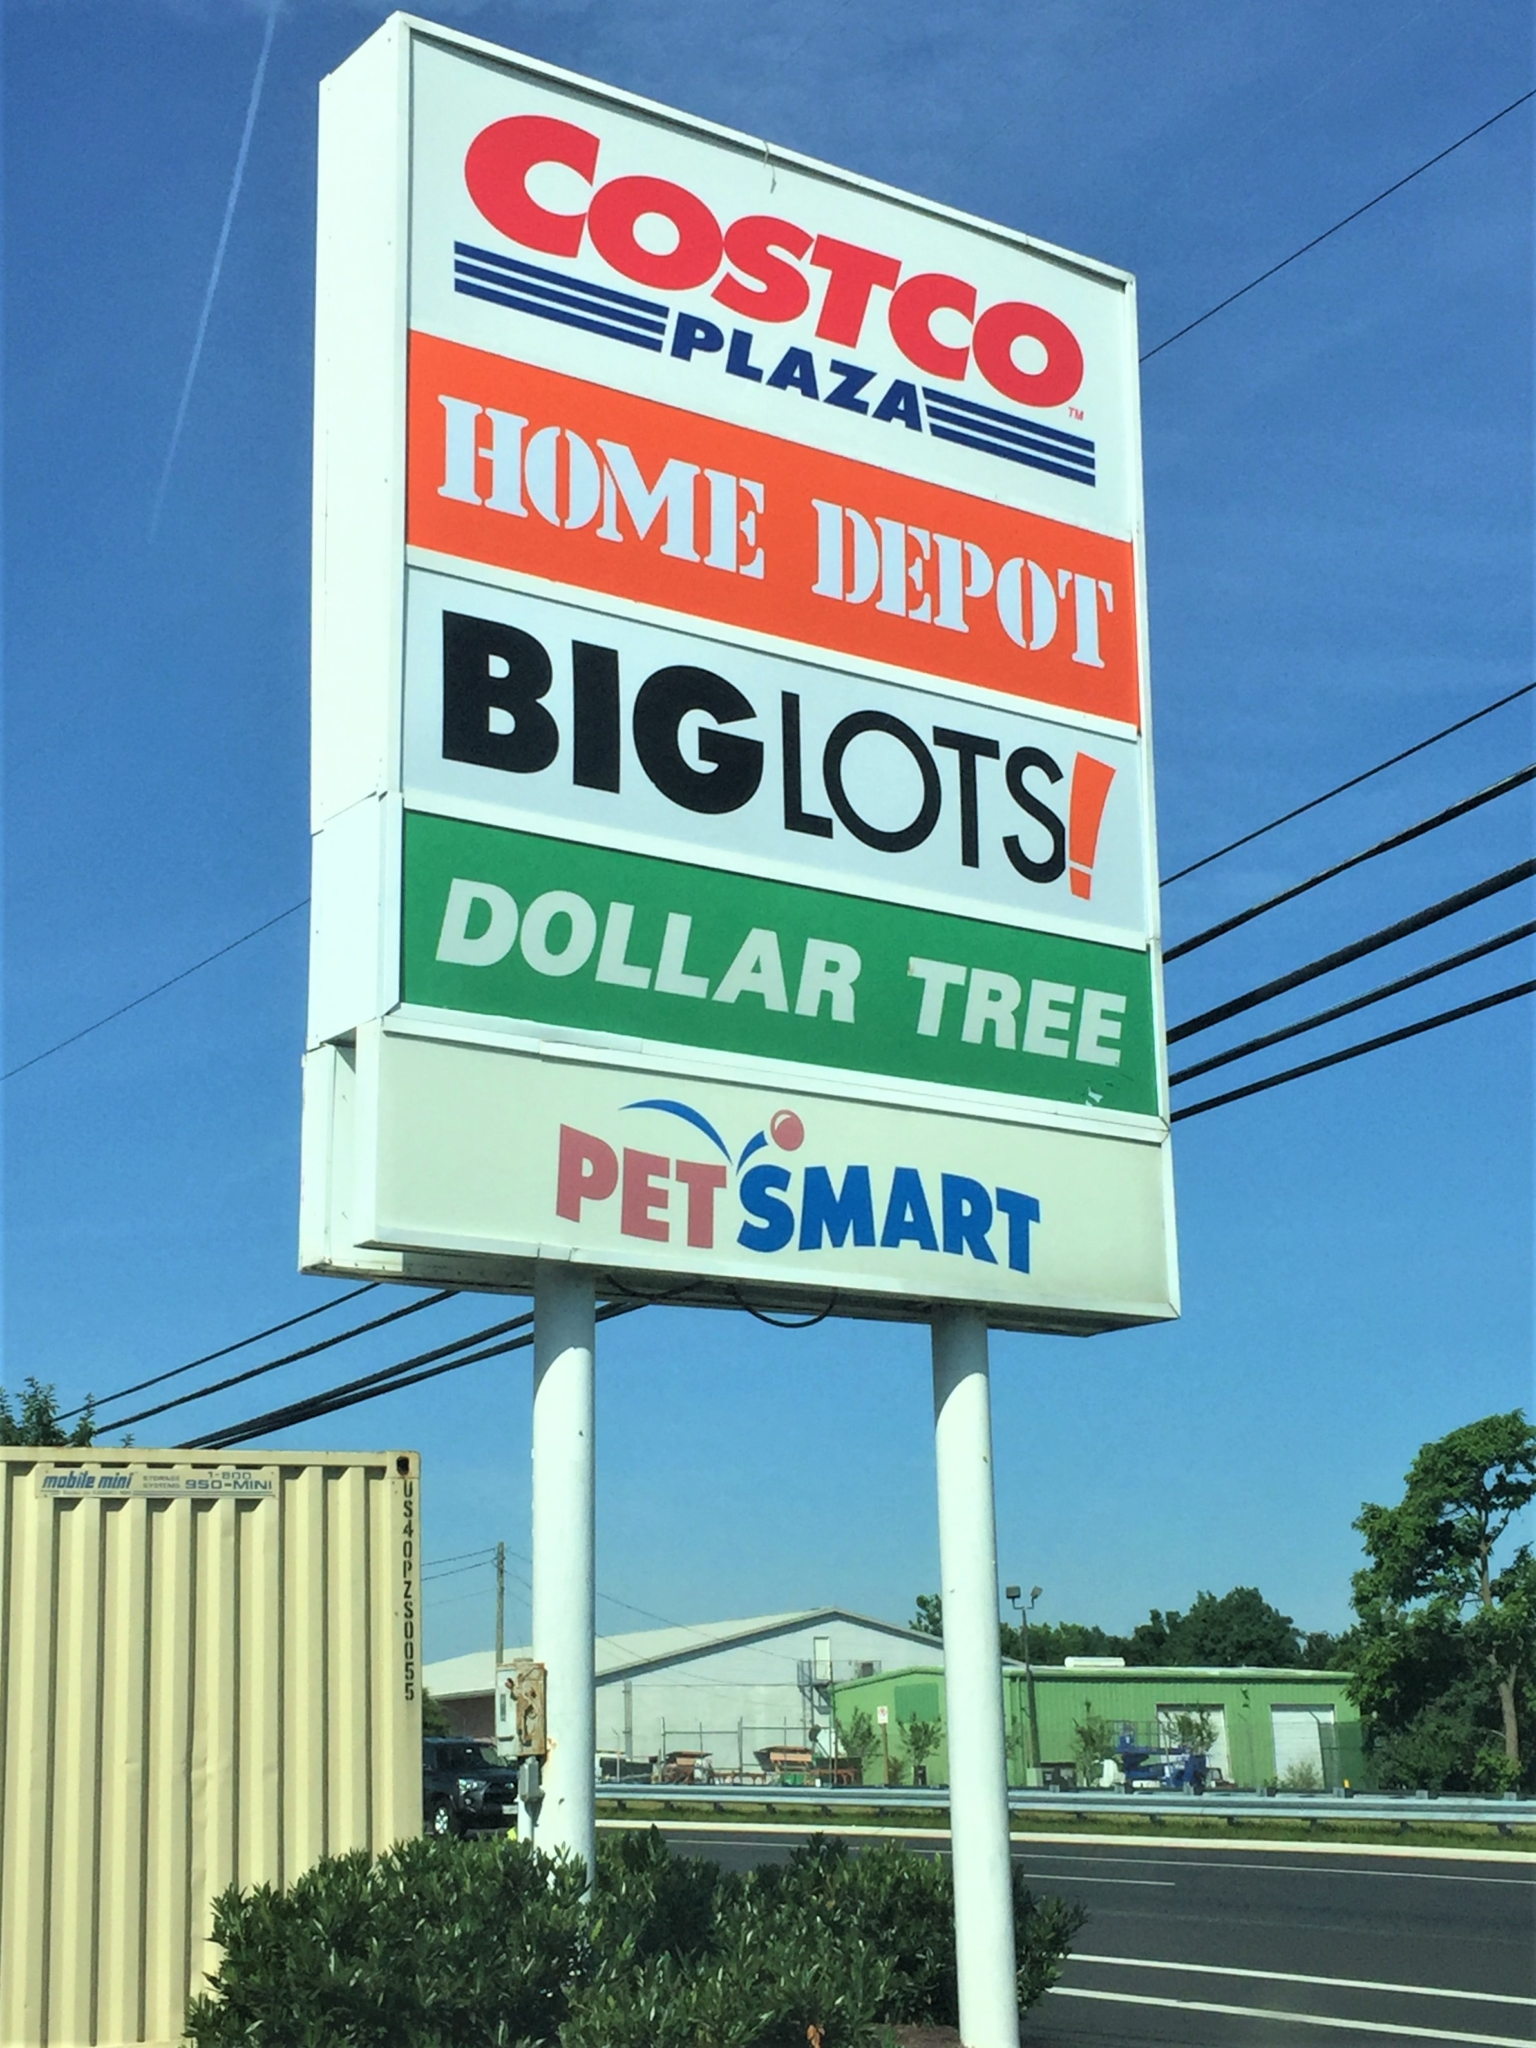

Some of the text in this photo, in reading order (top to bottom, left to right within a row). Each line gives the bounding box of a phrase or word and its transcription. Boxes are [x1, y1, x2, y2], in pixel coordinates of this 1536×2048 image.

[464, 114, 1084, 409] COSTCO
[670, 310, 923, 433] PLAZA
[1068, 405, 1085, 421] TM
[437, 394, 1114, 669] HOME DEPOT
[435, 878, 1128, 1068] DOLLAR TREE
[555, 1122, 1040, 1275] PETSMART
[42, 1470, 134, 1489] mobile mini
[185, 1479, 272, 1490] 950-MINI
[207, 1471, 252, 1480] 1-800
